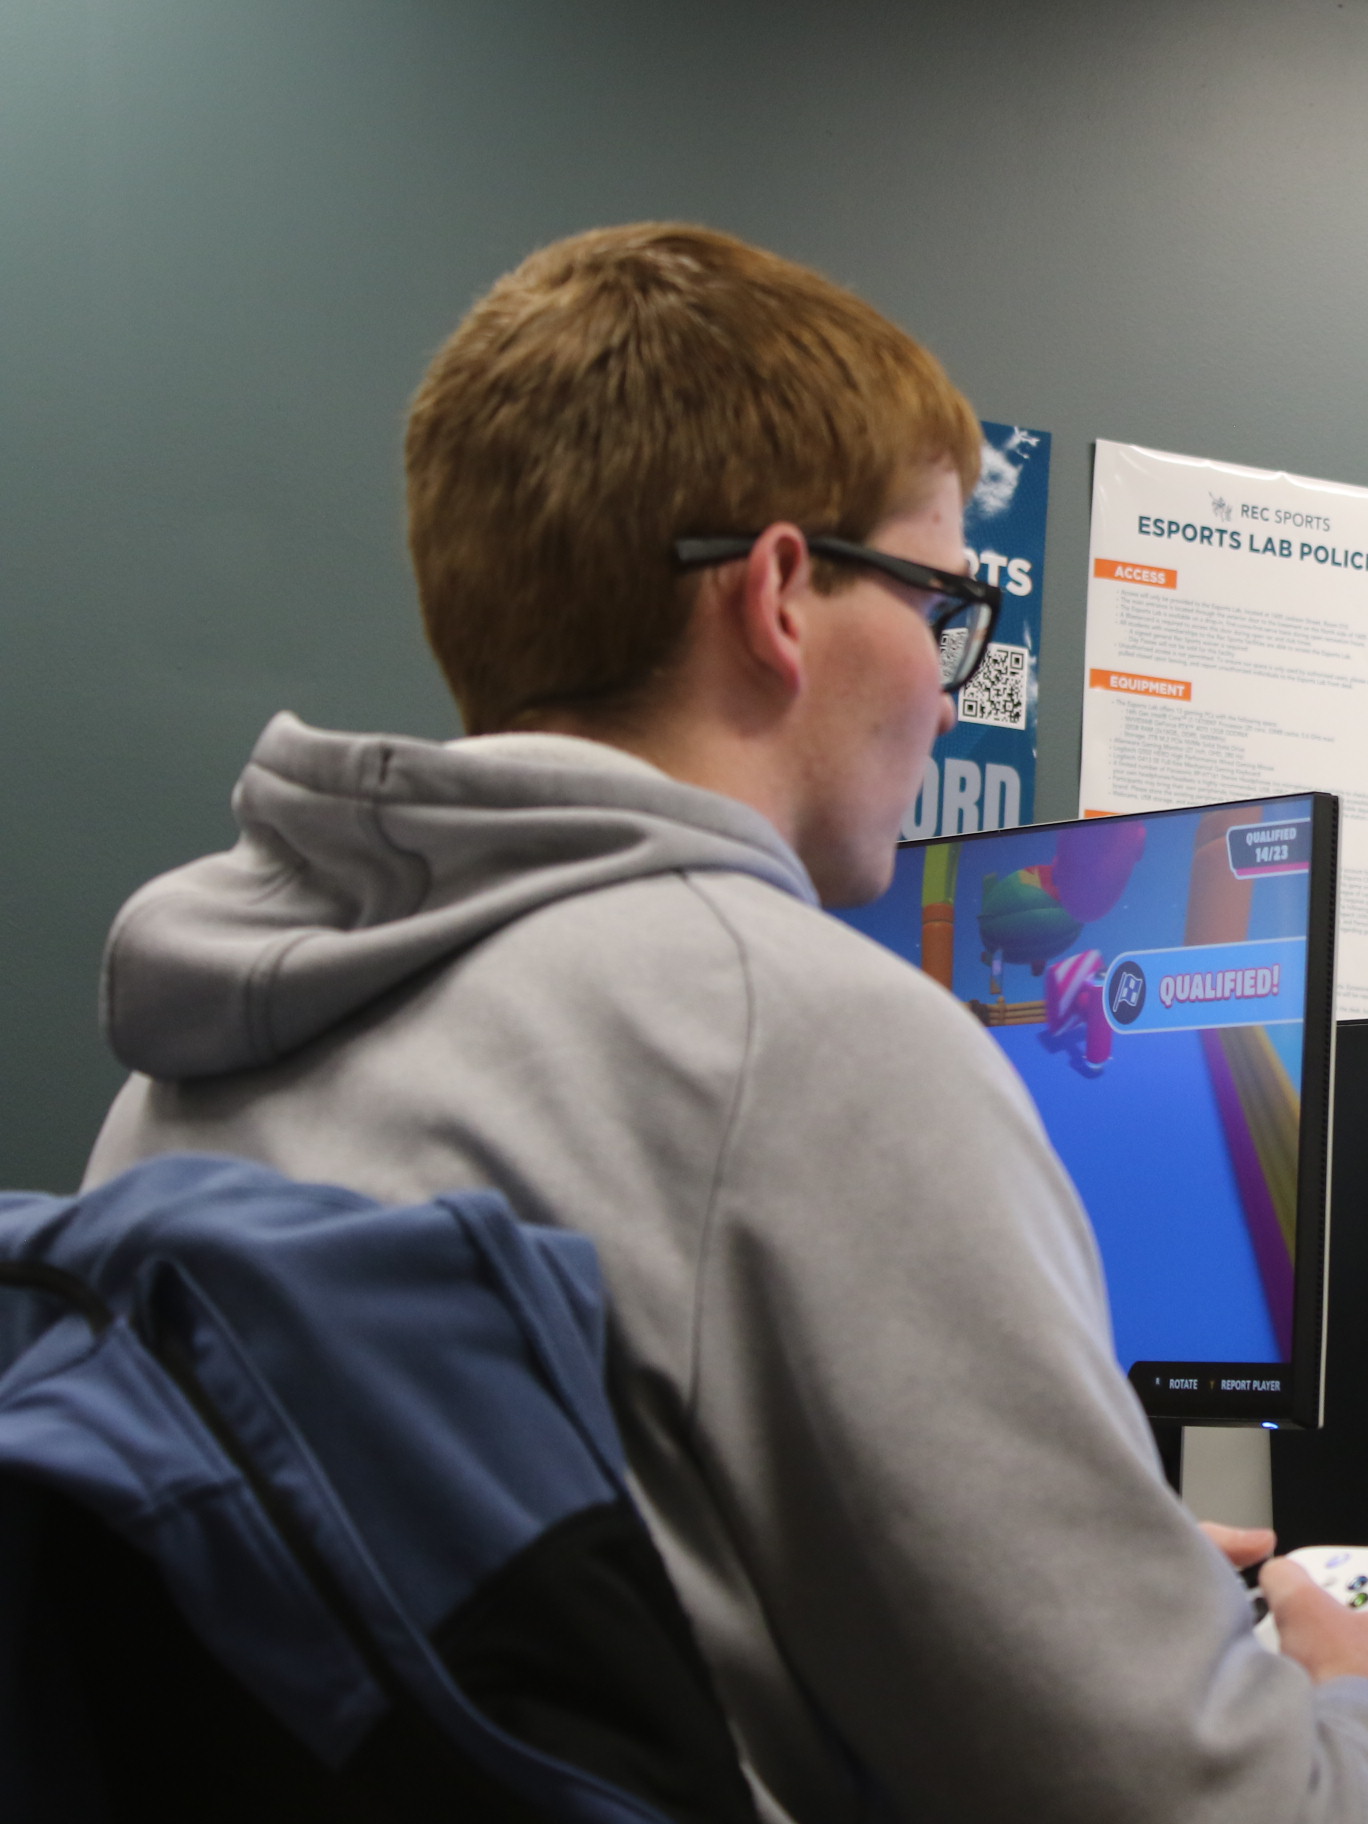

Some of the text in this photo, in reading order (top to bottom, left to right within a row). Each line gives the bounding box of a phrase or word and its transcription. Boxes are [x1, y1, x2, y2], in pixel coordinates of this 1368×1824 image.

[1240, 503, 1331, 532] REC SPORTS
[1137, 515, 1242, 550] ESPORTS
[1249, 534, 1292, 559] LAB
[1114, 565, 1167, 584] ACCESS
[1109, 675, 1186, 697] EQUIPMENT
[1246, 827, 1297, 846] QUALIFIED
[1255, 845, 1289, 863] 14/23
[1159, 964, 1281, 1009] QUALIFIED!
[1168, 1379, 1198, 1390] ROTATE
[1220, 1379, 1251, 1391] REPORT
[1252, 1380, 1281, 1391] PLAYER
